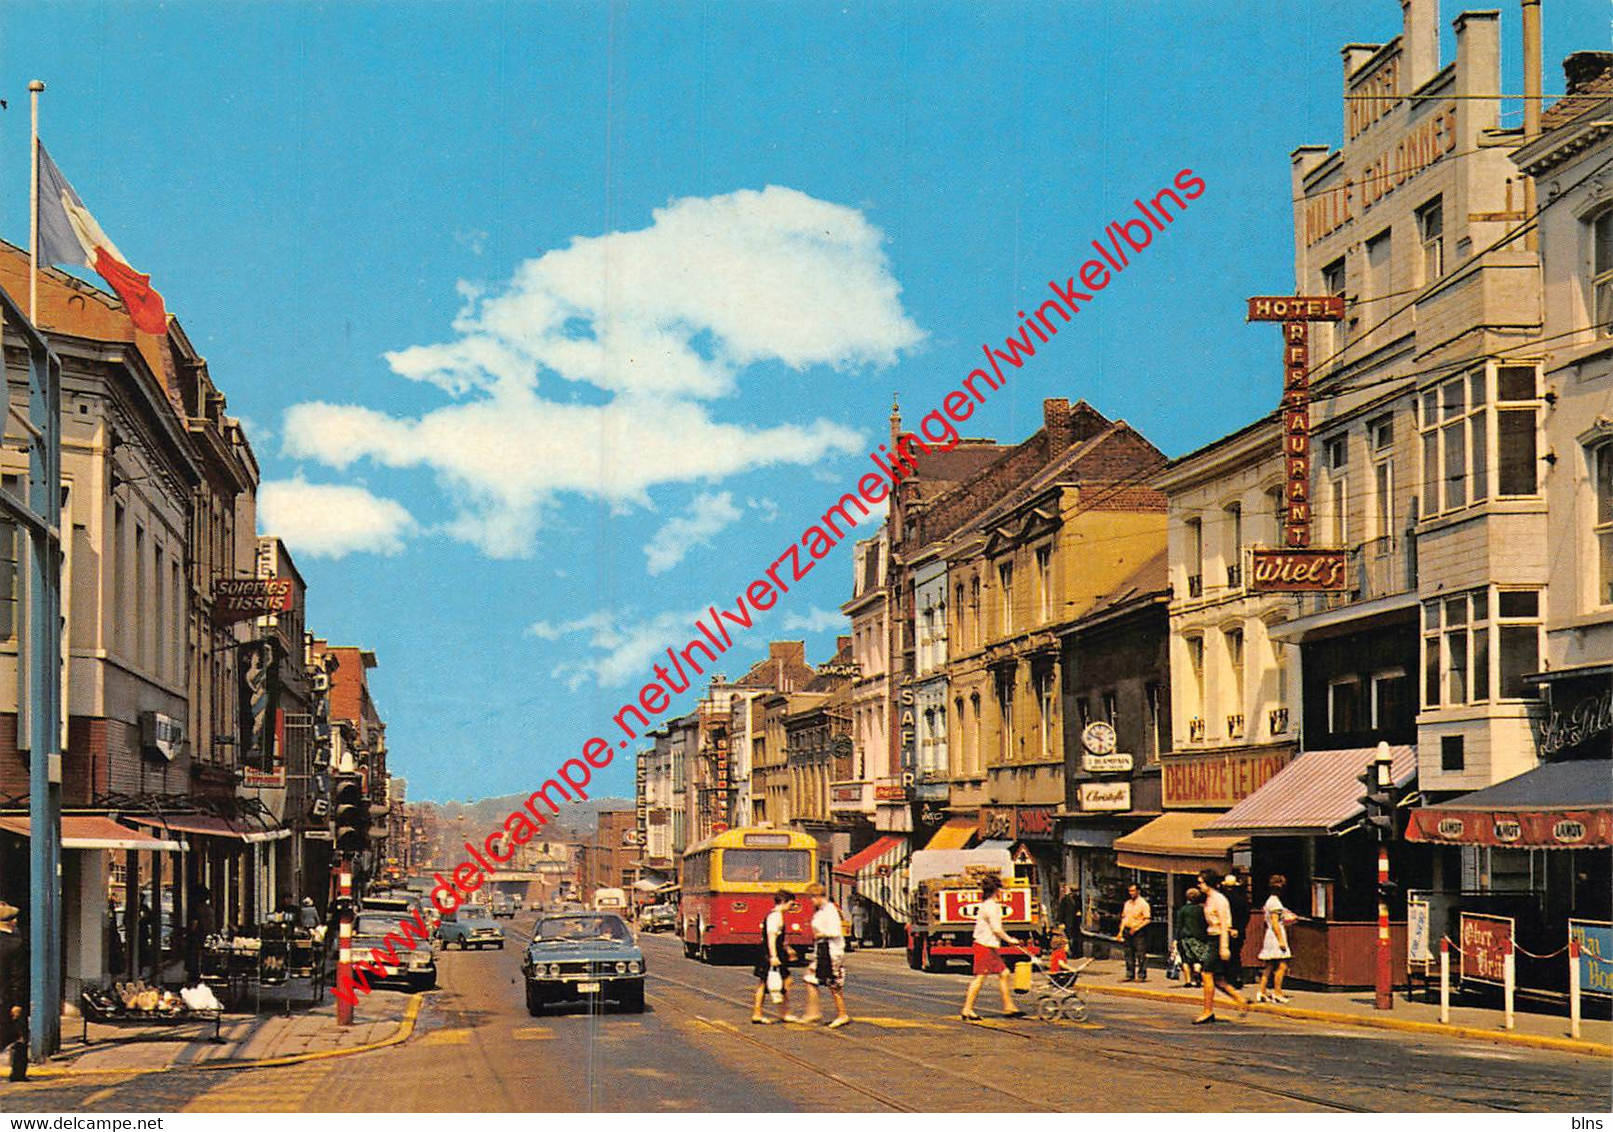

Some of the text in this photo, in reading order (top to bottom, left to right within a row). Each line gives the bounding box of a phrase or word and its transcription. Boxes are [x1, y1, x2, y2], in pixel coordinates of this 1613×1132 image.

[1256, 300, 1338, 317] HOTEL
[1290, 324, 1305, 543] RESTAURANT
[1256, 554, 1343, 587] Wiel's
[901, 688, 915, 788] SAFIR
[957, 892, 1013, 902] PILOR
[963, 906, 1007, 916] LAT
